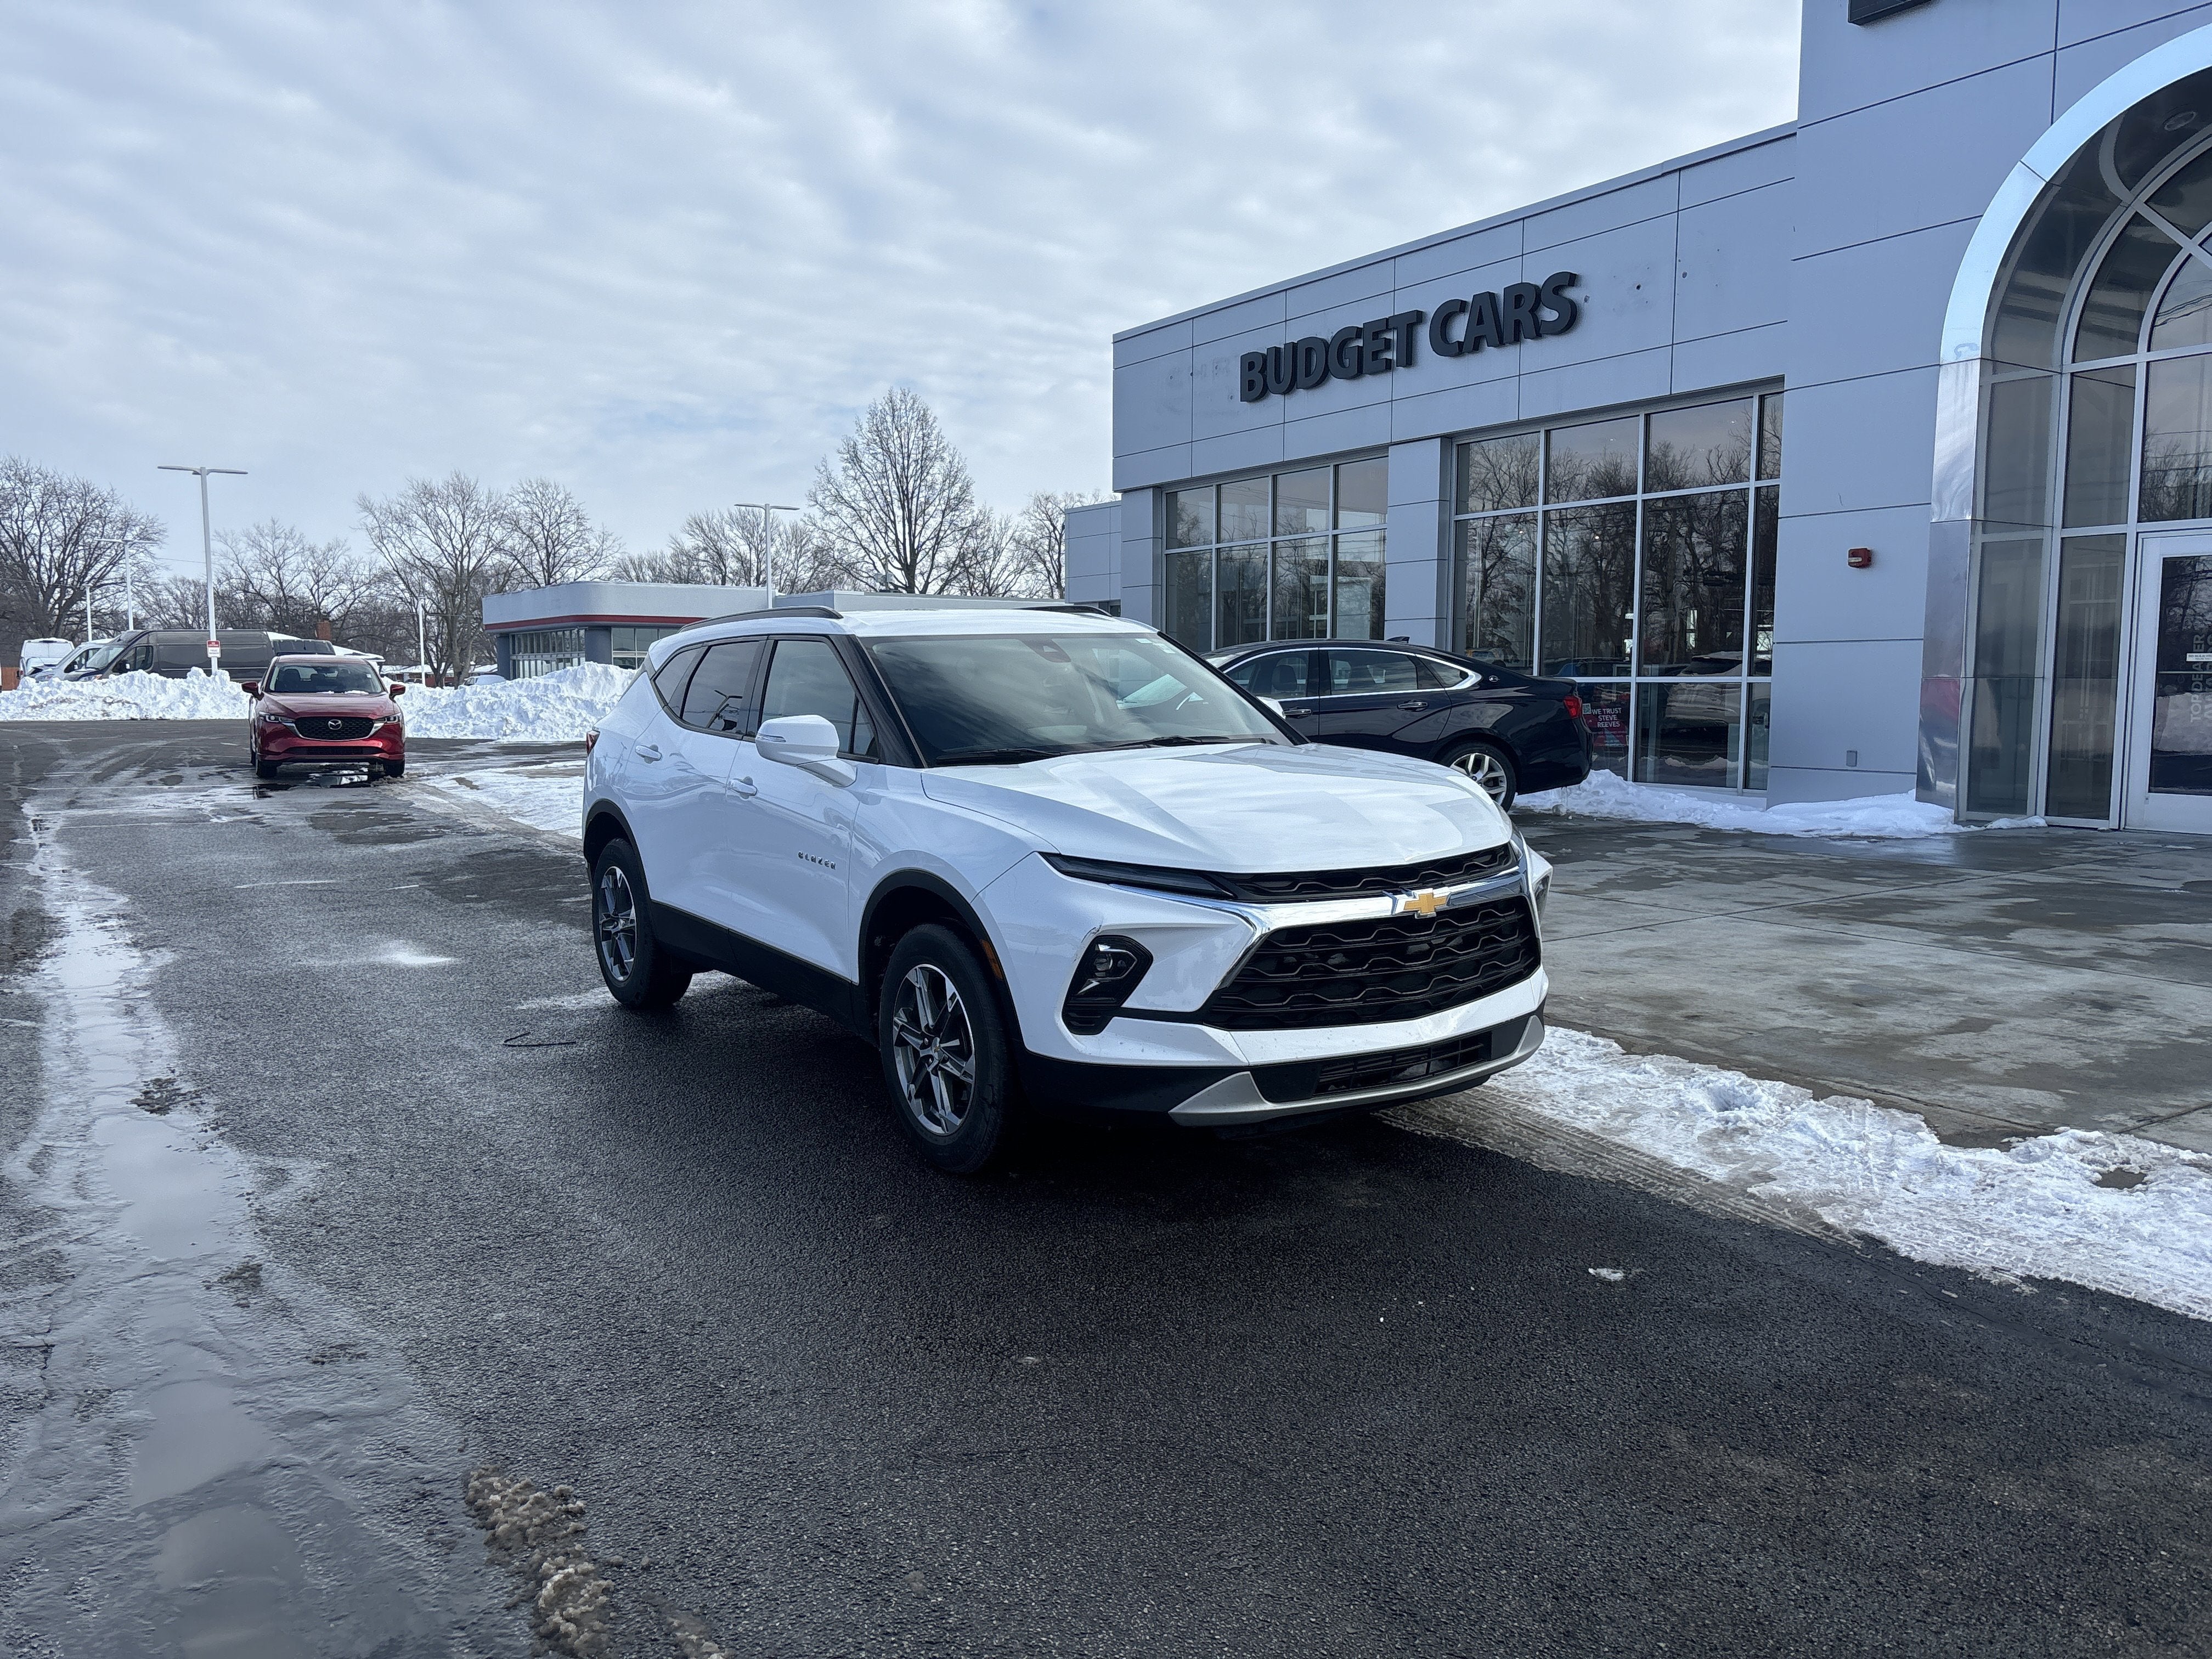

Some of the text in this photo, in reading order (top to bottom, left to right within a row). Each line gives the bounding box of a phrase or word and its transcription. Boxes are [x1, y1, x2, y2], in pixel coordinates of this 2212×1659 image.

[1240, 271, 1579, 402] BUDGET CARS
[2191, 634, 2205, 692] DEAER
[2190, 693, 2202, 723] TOP
